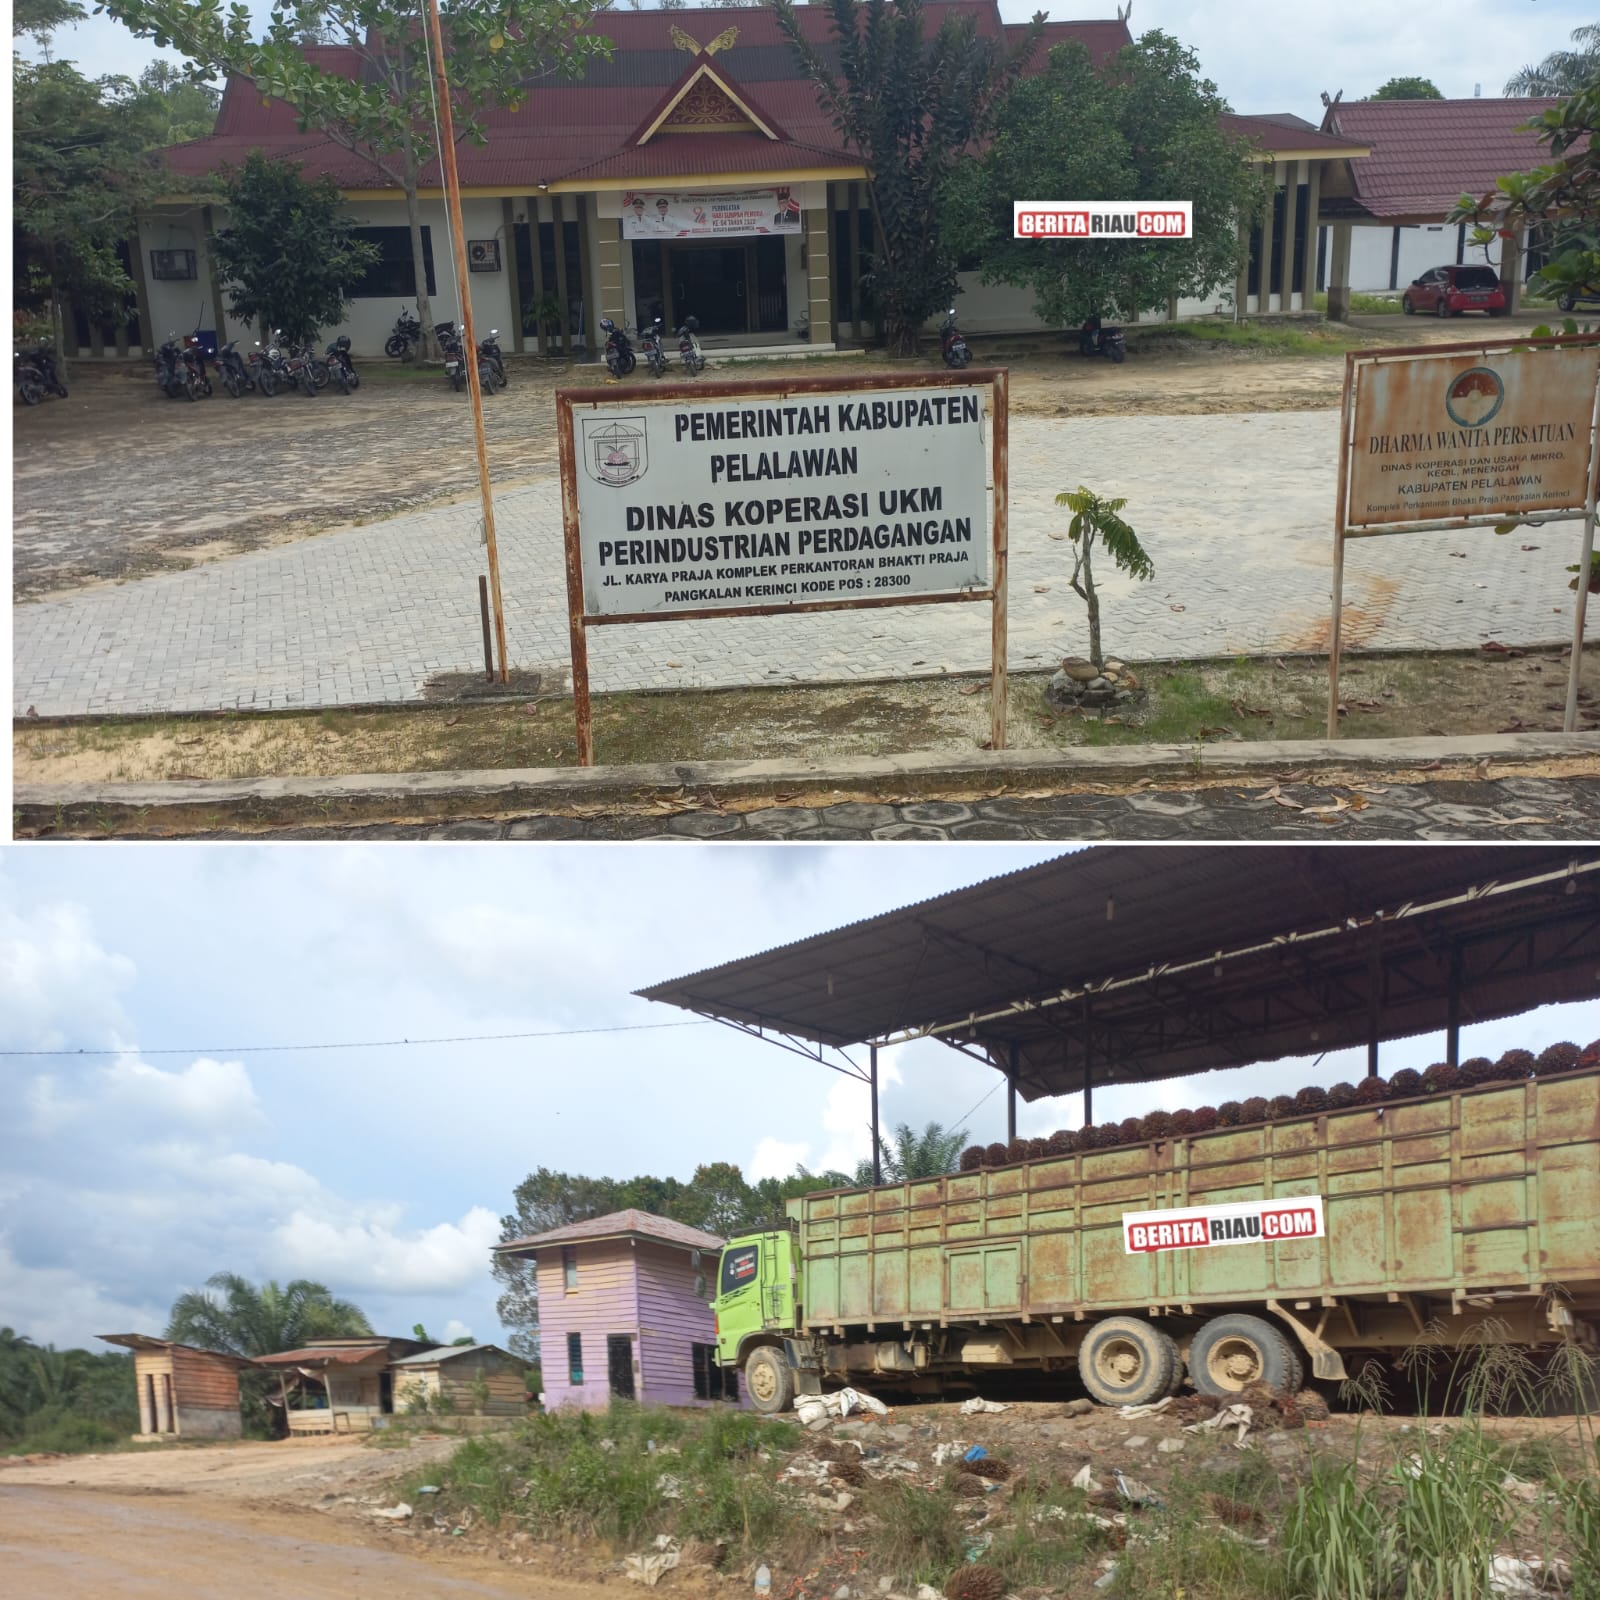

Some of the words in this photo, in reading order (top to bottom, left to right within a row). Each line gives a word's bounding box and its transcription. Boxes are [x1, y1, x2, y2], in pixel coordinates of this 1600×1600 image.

[674, 405, 830, 442] PEMERINTAH
[838, 395, 979, 431] KABUPATEN
[1369, 433, 1433, 455] DHARMA
[1436, 428, 1490, 449] WANITA
[1494, 422, 1576, 446] PERSATUAN
[710, 446, 858, 483] PELALAWAN
[1381, 462, 1412, 473] DINAS
[1415, 458, 1467, 470] KOPERASI
[1469, 456, 1491, 466] DAN
[1493, 454, 1528, 465] USAHA
[1462, 464, 1520, 475] MENENGAH
[1366, 503, 1400, 513] Komplek
[1451, 496, 1477, 506] Bhakti
[1478, 494, 1499, 505] Praja
[1500, 492, 1541, 503] Pangkalan
[1542, 489, 1570, 500] Kerinci
[1398, 479, 1468, 495] KABUPATEN
[1471, 475, 1542, 490] PELALAWAN
[626, 500, 715, 532] DINAS
[725, 492, 869, 528] KOPERASI
[879, 486, 942, 516] UKM
[598, 531, 791, 567] PERINDUSTRIAN
[799, 517, 971, 555] PERDAGANGAN
[602, 573, 622, 587] JL.
[625, 571, 668, 585] KARYA
[672, 569, 713, 583] PRAJA
[716, 564, 777, 581] KOMPLEK
[780, 558, 875, 577] PERKANTORAN
[879, 554, 925, 569] BHAKTI
[929, 550, 969, 565] PRAJA
[664, 586, 742, 603] PANGKALAN
[745, 582, 798, 598] KERINCI
[800, 579, 836, 594] KODE
[838, 577, 864, 591] POS
[874, 574, 911, 589] 28300
